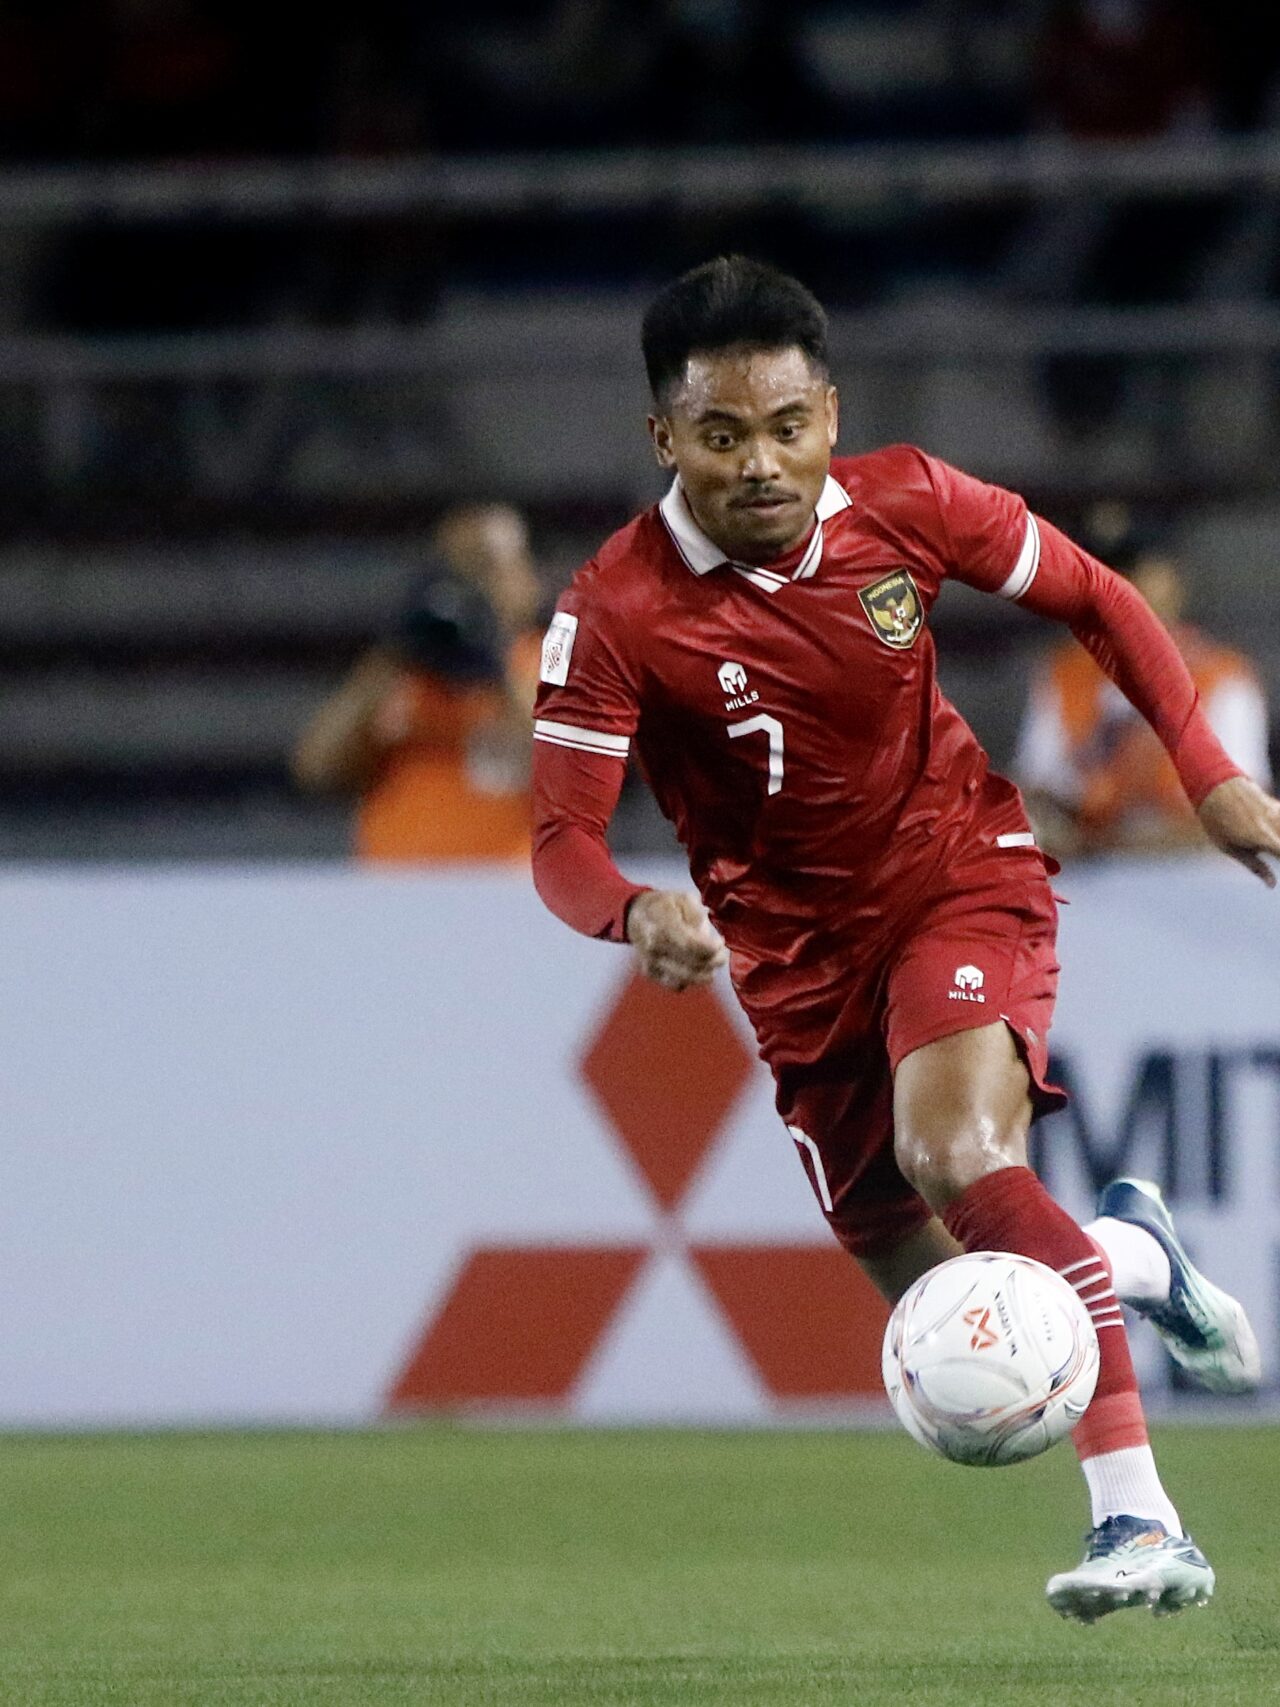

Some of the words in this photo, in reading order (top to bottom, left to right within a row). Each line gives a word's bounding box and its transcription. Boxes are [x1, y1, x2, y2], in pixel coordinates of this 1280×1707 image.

[725, 690, 760, 712] MILLS
[726, 712, 784, 797] 7
[948, 990, 986, 1004] MILLS
